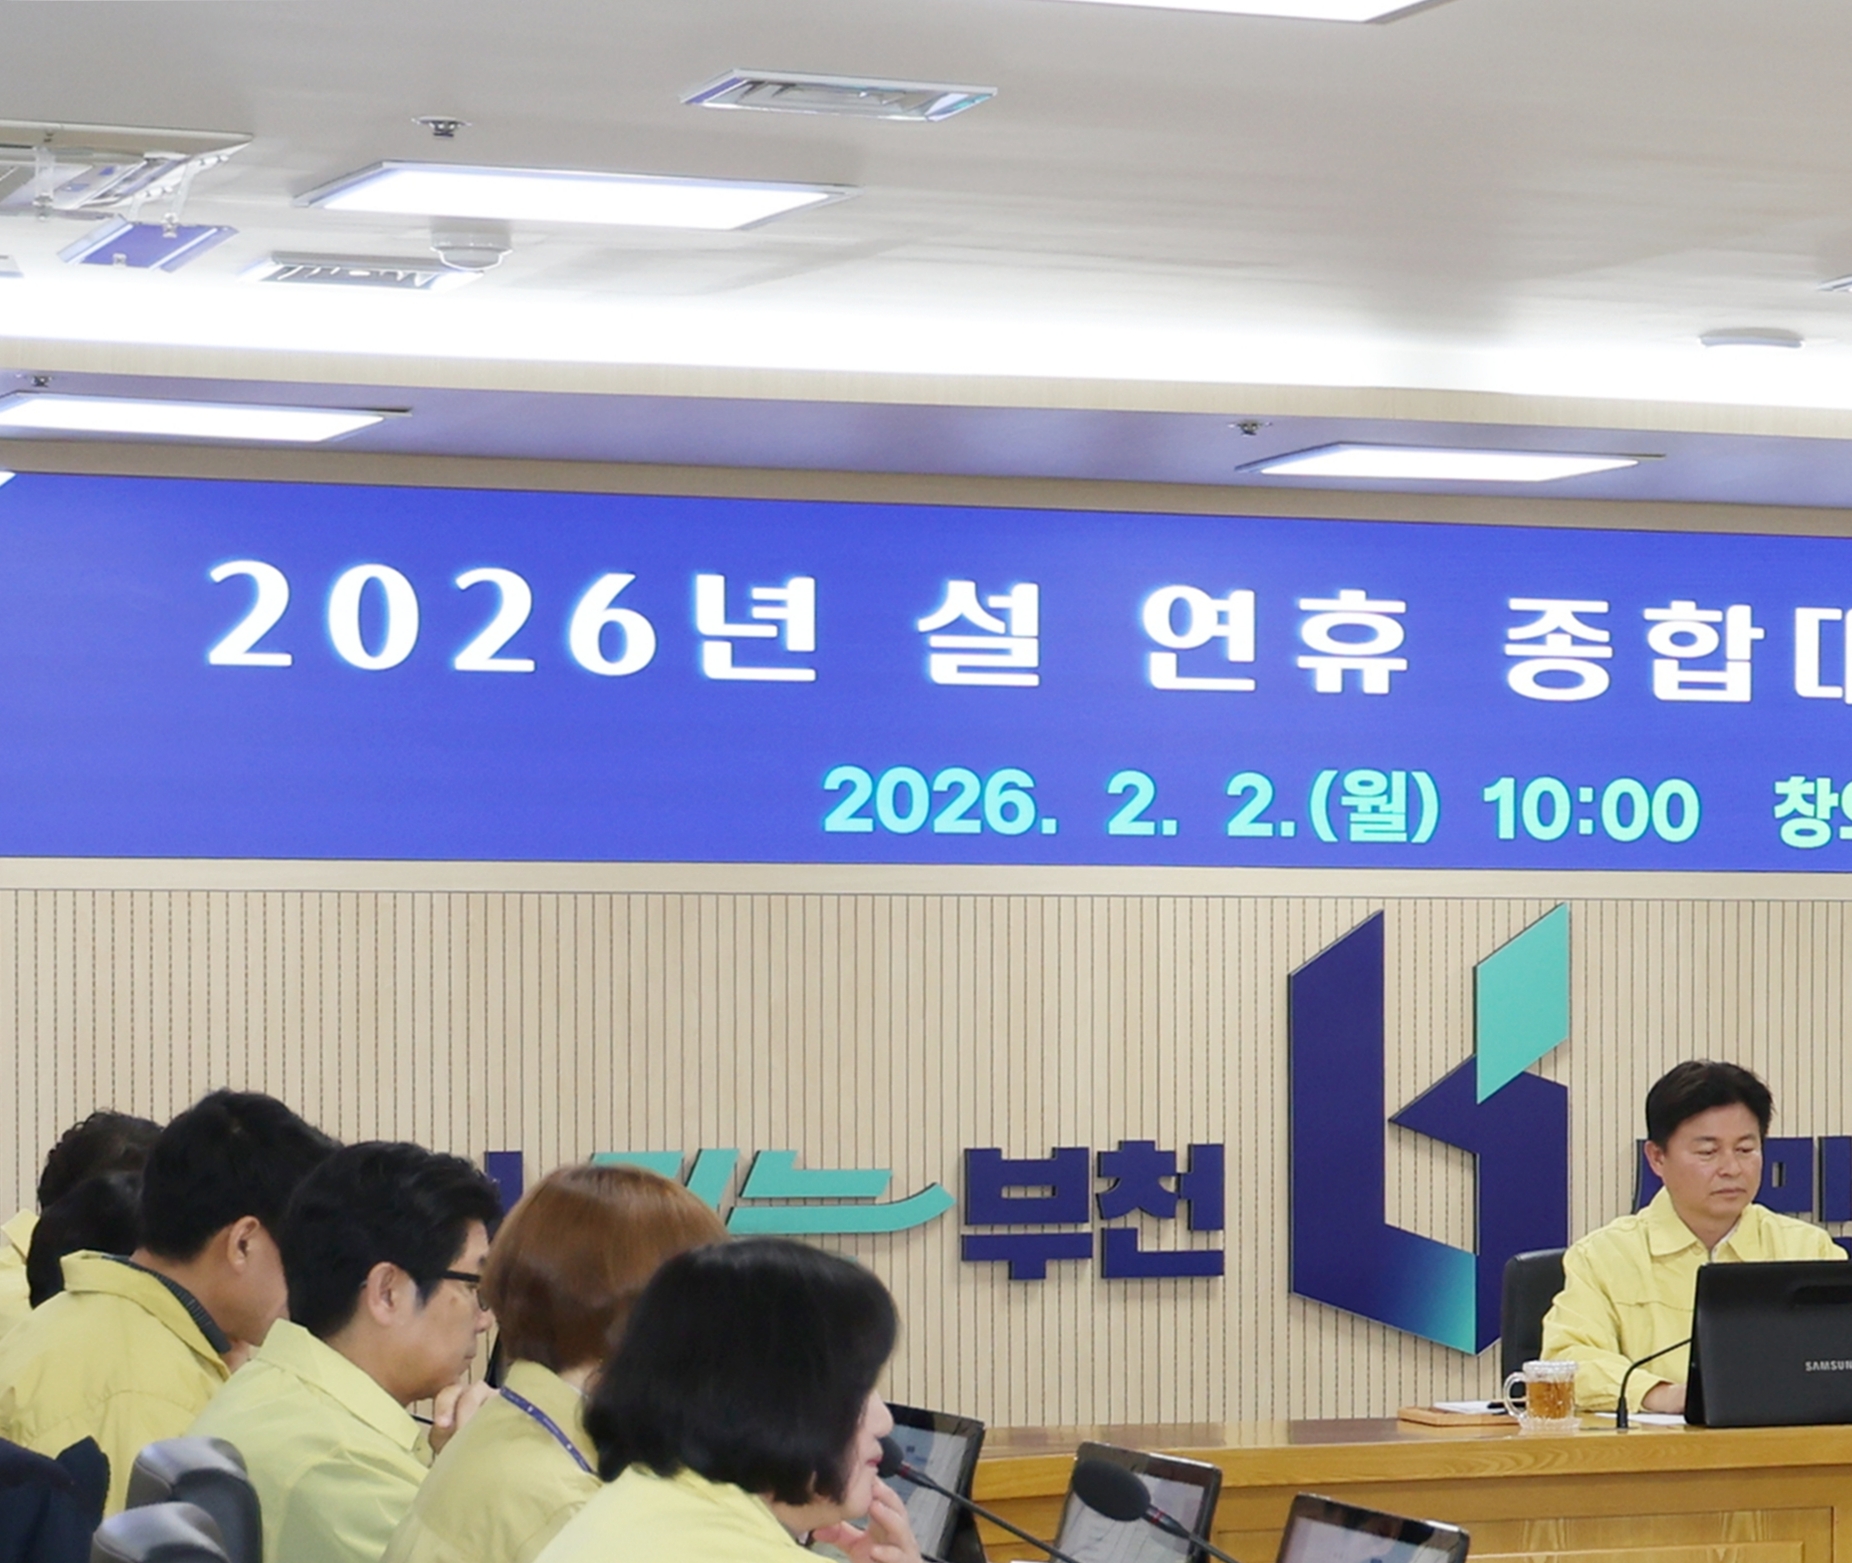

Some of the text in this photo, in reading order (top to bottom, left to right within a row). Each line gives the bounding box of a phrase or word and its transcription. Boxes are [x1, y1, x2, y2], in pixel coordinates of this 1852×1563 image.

[206, 557, 819, 684] 2026년
[914, 577, 1042, 689] 설
[1139, 581, 1410, 697] 연휴
[822, 764, 1059, 837] 2026.
[1105, 768, 1179, 838] 2.
[1225, 767, 1441, 846] 2.(월)
[1481, 775, 1702, 844] 10:00
[961, 1139, 1225, 1281] 부천
